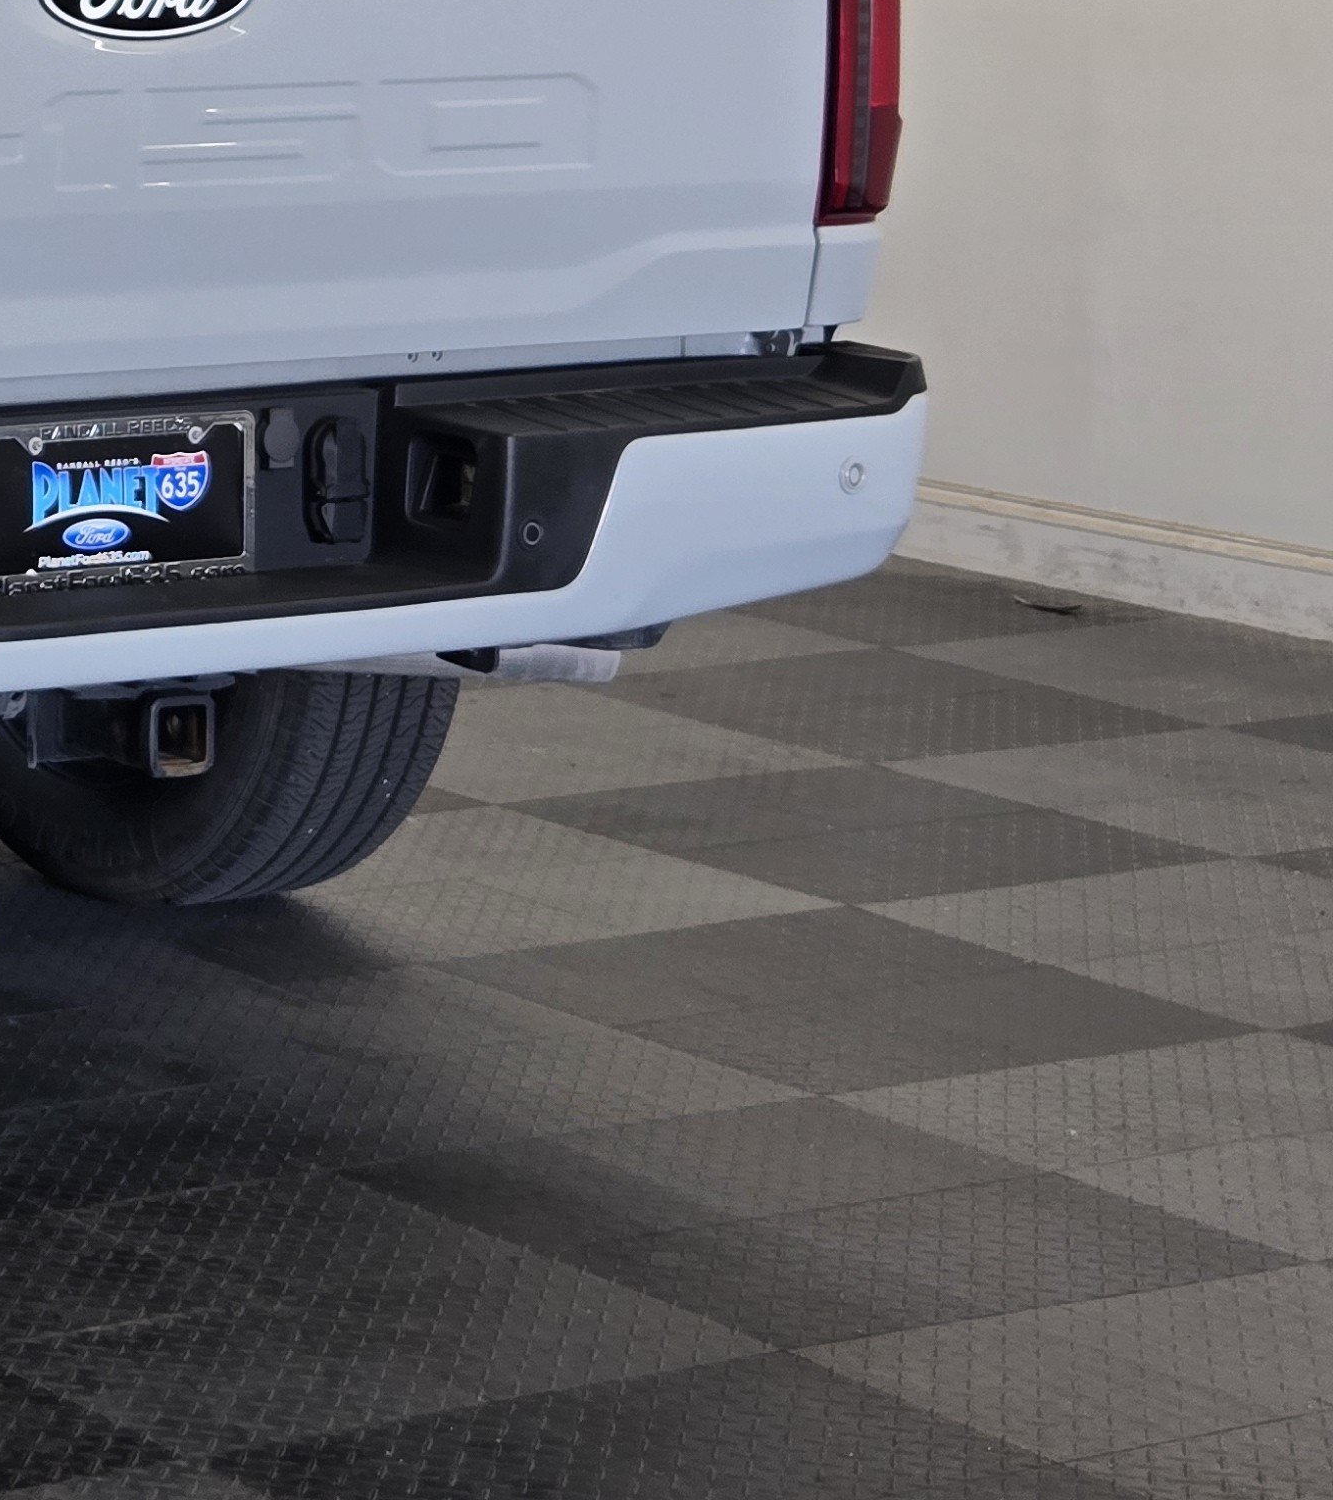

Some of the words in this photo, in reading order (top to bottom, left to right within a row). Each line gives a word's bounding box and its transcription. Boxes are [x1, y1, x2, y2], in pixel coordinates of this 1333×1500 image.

[38, 421, 123, 441] RANDALL
[56, 460, 101, 470] RANDALL
[32, 461, 159, 527] PLANET
[161, 471, 200, 498] 635
[74, 525, 115, 545] Ford
